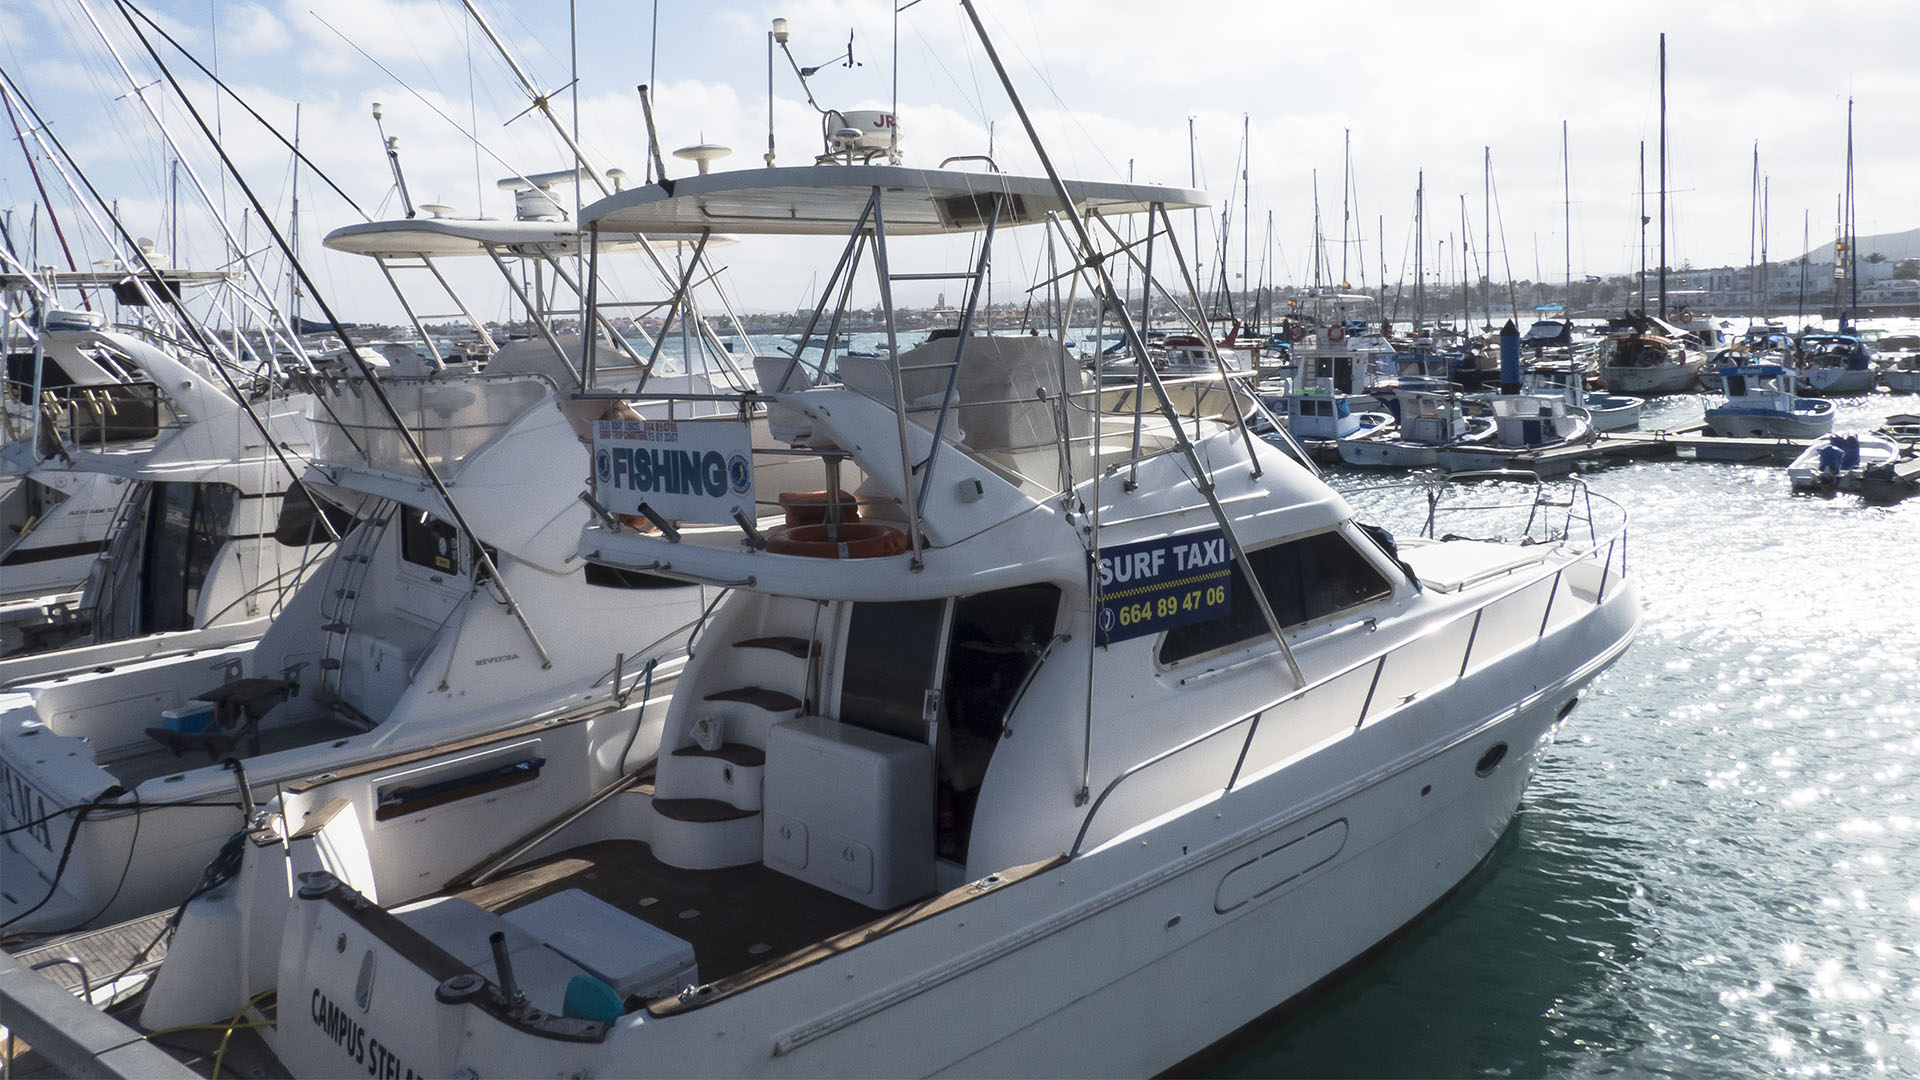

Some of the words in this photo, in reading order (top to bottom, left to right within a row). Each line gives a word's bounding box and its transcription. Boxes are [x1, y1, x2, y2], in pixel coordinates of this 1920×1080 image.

[612, 447, 728, 497] FISHING
[1099, 549, 1166, 586] SURF
[1173, 538, 1225, 571] TAXI
[1120, 601, 1152, 626] 664
[1157, 596, 1178, 618] 89
[1182, 591, 1202, 611] 47
[1206, 585, 1225, 606] 06
[311, 987, 365, 1065] CAMPUS
